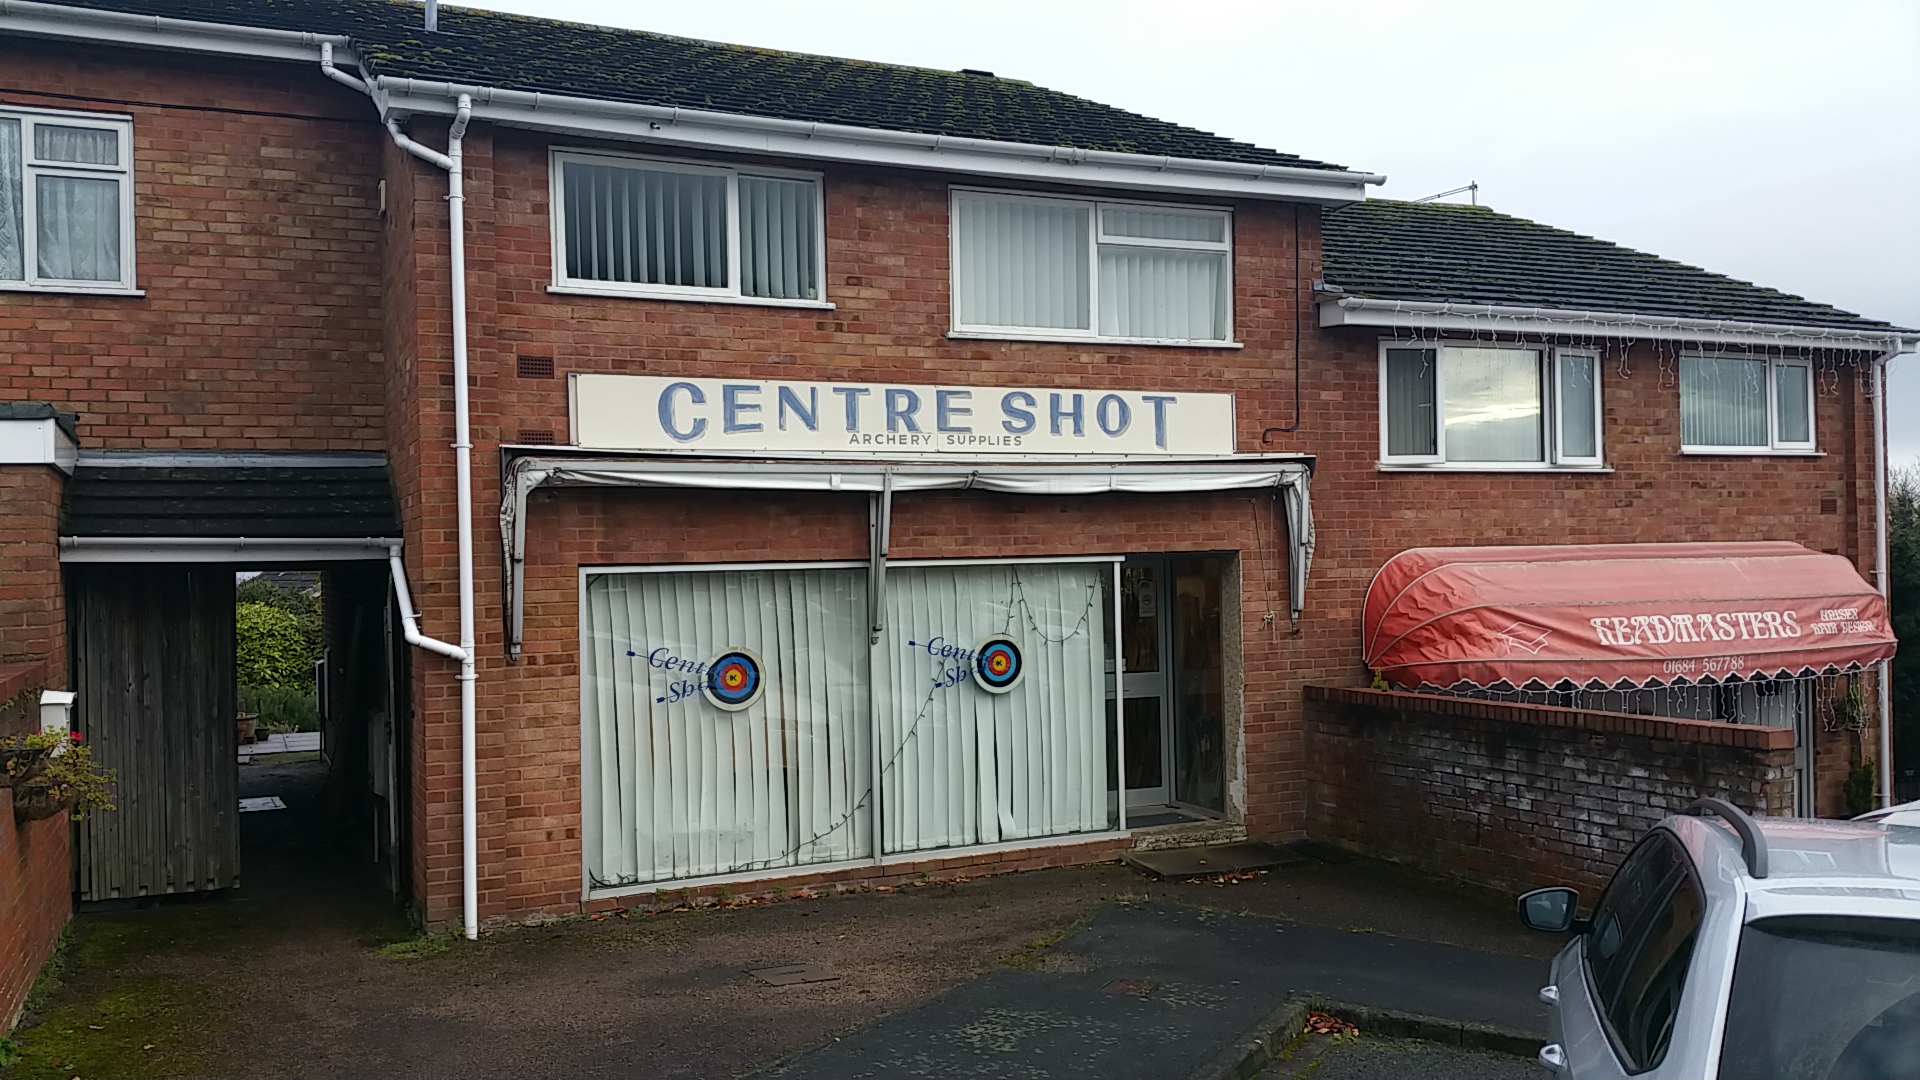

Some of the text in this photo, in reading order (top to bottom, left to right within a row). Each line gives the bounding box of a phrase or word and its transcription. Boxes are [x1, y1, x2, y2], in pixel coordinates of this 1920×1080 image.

[658, 381, 1178, 451] CENTRE SHOT
[849, 433, 1022, 446] ARCHERY SUPPLIES
[1820, 608, 1859, 621] UNISEX
[1590, 610, 1801, 646] HEADMASTERS
[1810, 622, 1838, 635] HAIR
[1663, 656, 1745, 674] 01684 567788
